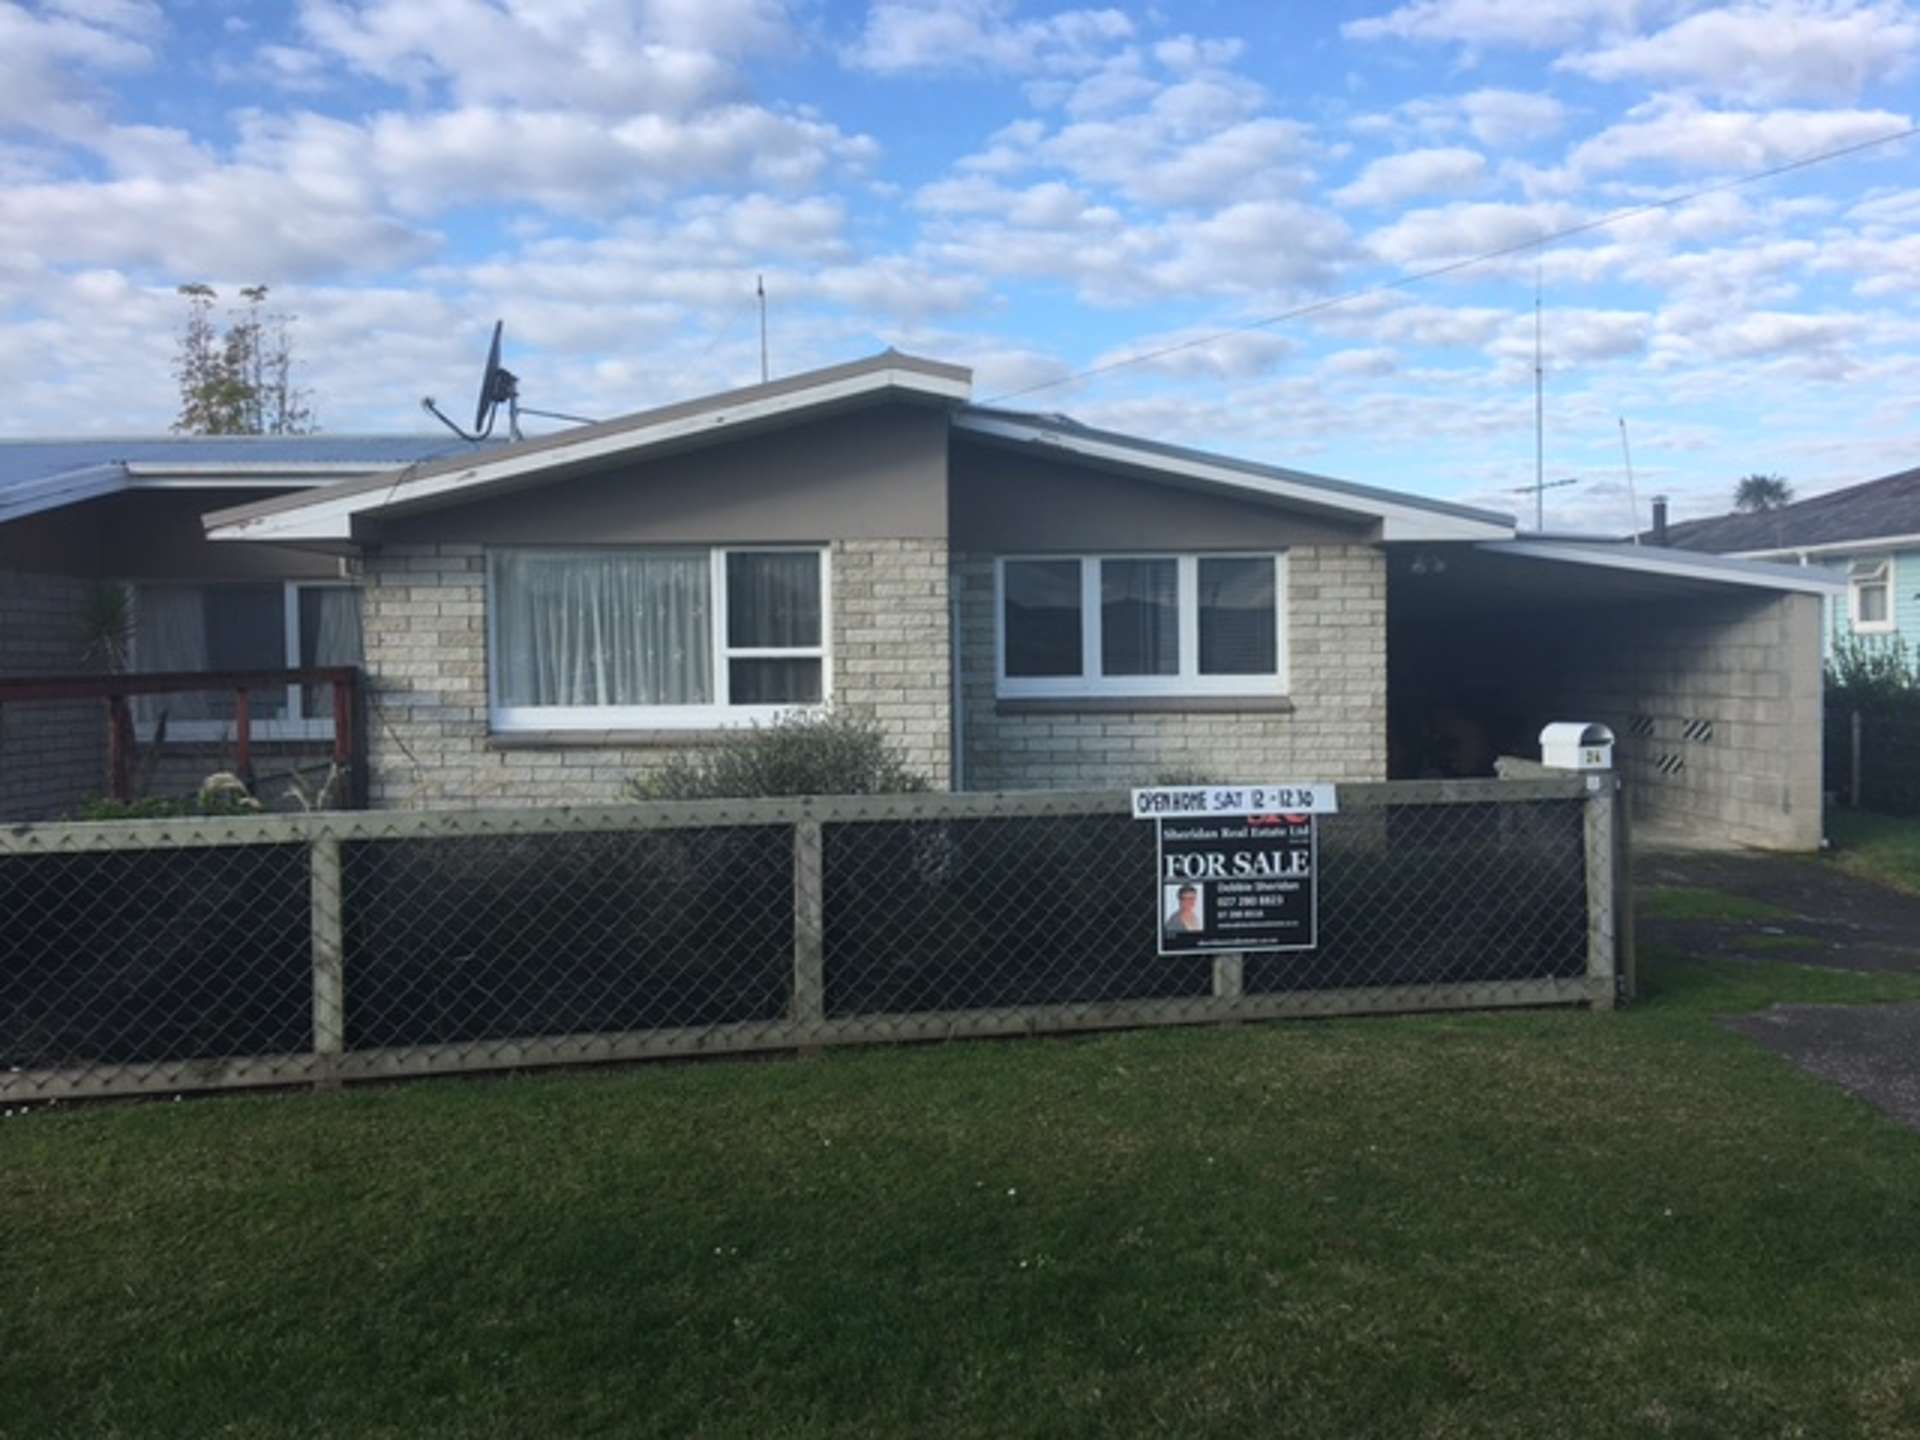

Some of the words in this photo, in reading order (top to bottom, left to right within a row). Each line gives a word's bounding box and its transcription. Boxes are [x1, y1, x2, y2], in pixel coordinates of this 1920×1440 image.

[1213, 790, 1243, 810] SAT
[1163, 828, 1219, 840] Sheridan
[1220, 827, 1249, 838] Real
[1250, 826, 1287, 837] Estate
[1289, 824, 1309, 836] Ltd
[1165, 852, 1226, 879] FOR
[1232, 850, 1310, 877] SALE
